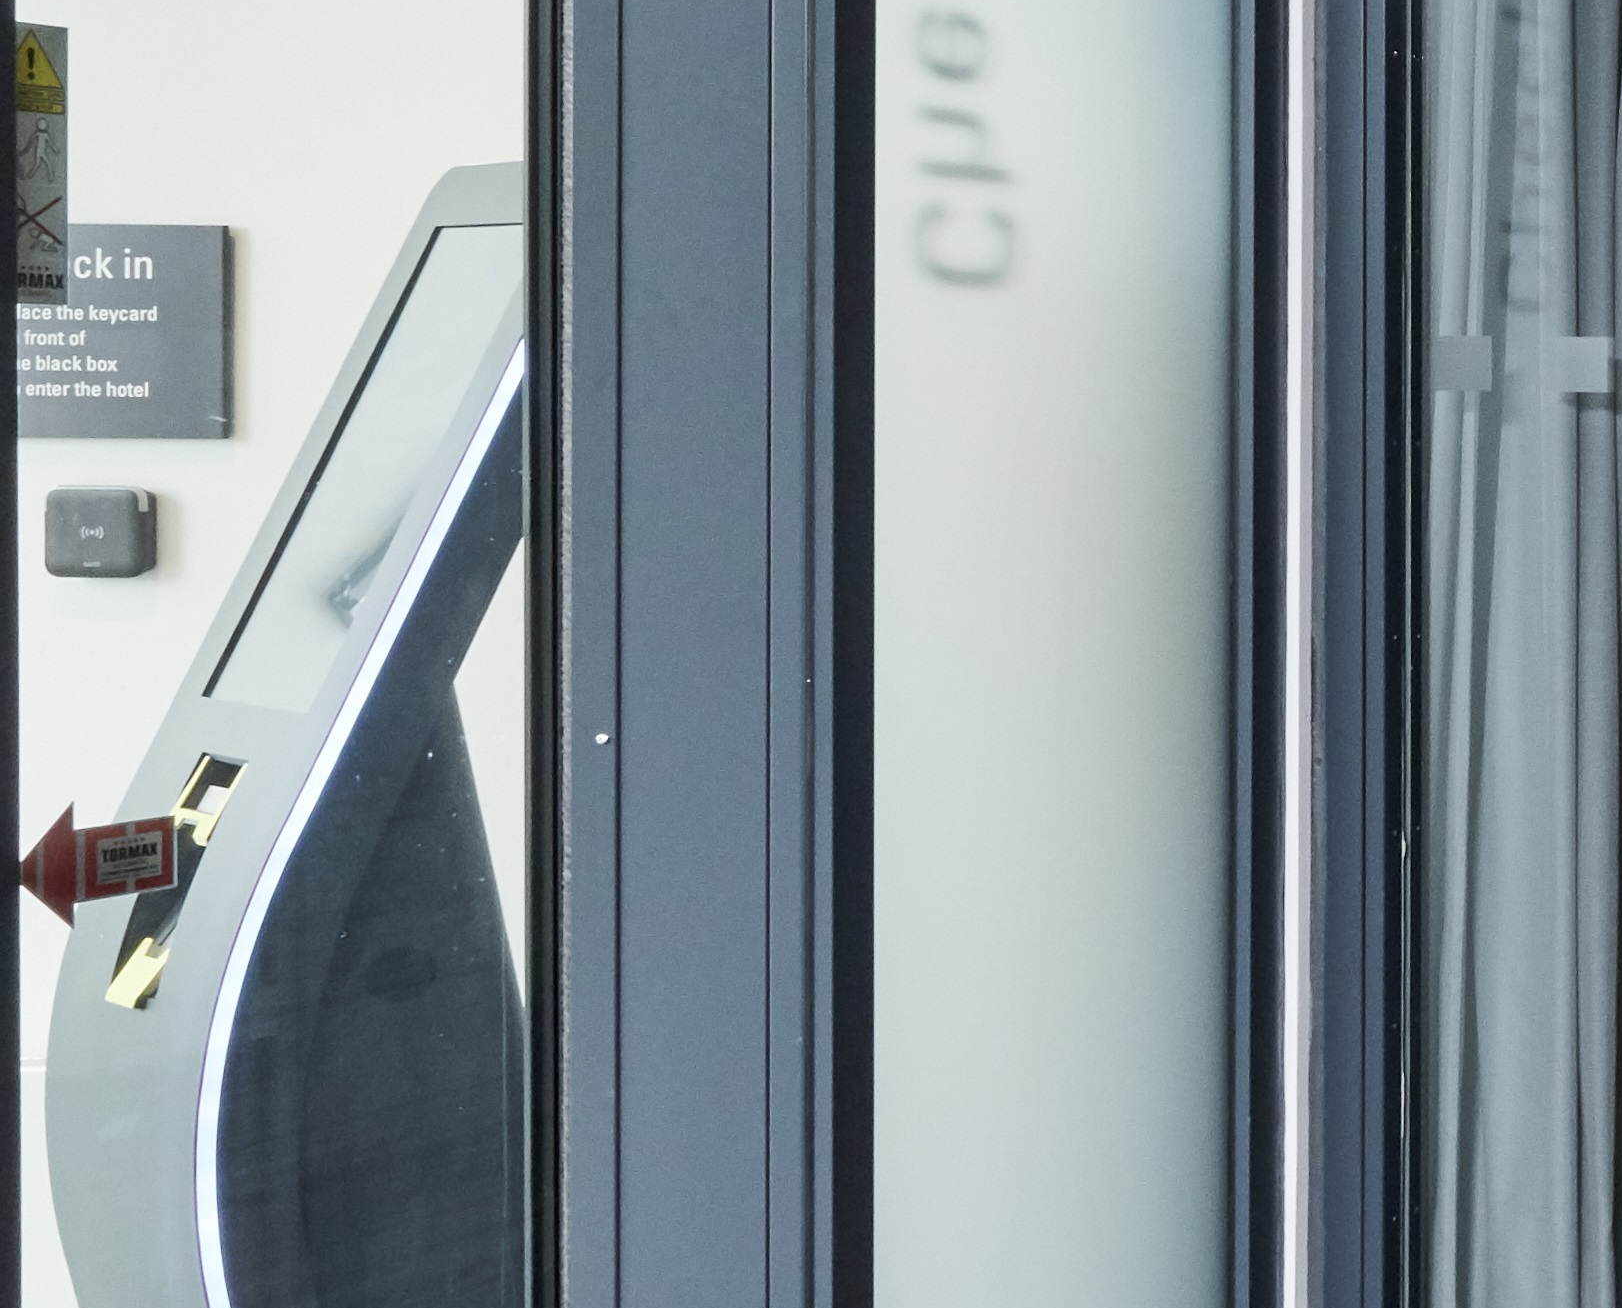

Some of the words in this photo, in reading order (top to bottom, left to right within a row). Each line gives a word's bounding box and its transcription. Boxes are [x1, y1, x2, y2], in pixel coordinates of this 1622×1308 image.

[124, 247, 153, 279] in
[18, 273, 64, 289] RMAX
[16, 302, 52, 320] lace
[56, 304, 85, 321] the
[89, 304, 158, 325] keycard
[24, 329, 65, 346] front
[69, 329, 87, 346] of
[36, 355, 82, 371] black
[86, 355, 118, 371] box
[25, 382, 70, 397] enter
[74, 381, 101, 397] the
[106, 381, 150, 398] hotel
[101, 842, 158, 864] TORMAX
